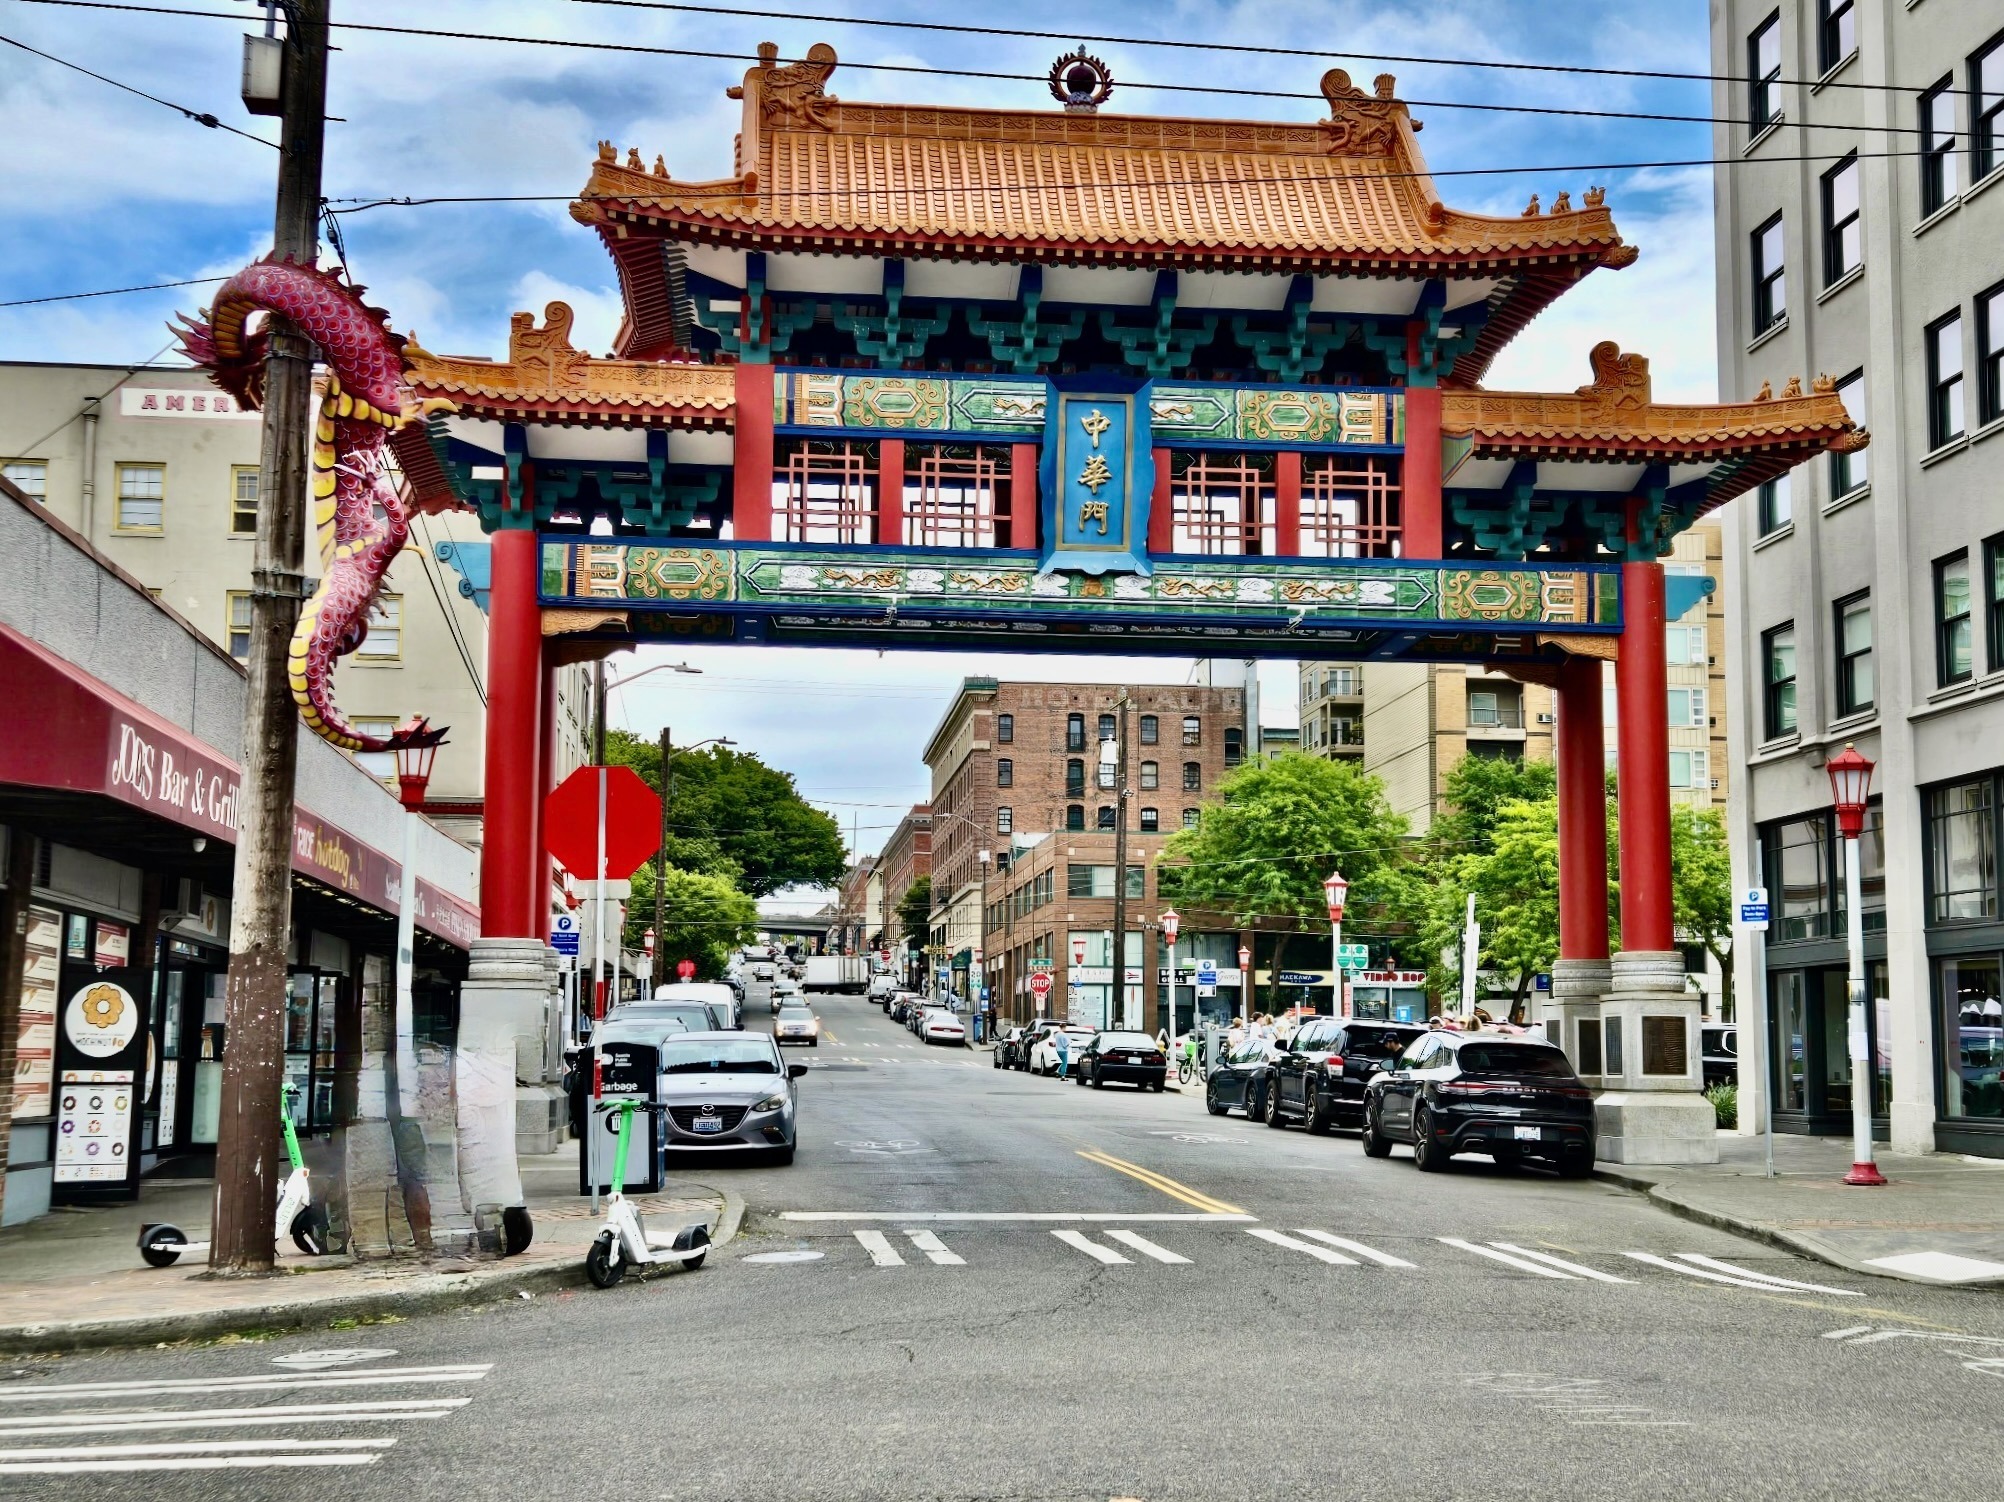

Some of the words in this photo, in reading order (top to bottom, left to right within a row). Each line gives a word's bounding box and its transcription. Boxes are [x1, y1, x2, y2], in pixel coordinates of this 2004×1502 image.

[1079, 408, 1113, 535] 中華門
[159, 750, 189, 808] Bar
[192, 768, 205, 815] &
[208, 775, 240, 830] Grill
[1031, 979, 1050, 988] STOP
[601, 1082, 638, 1092] Garbage
